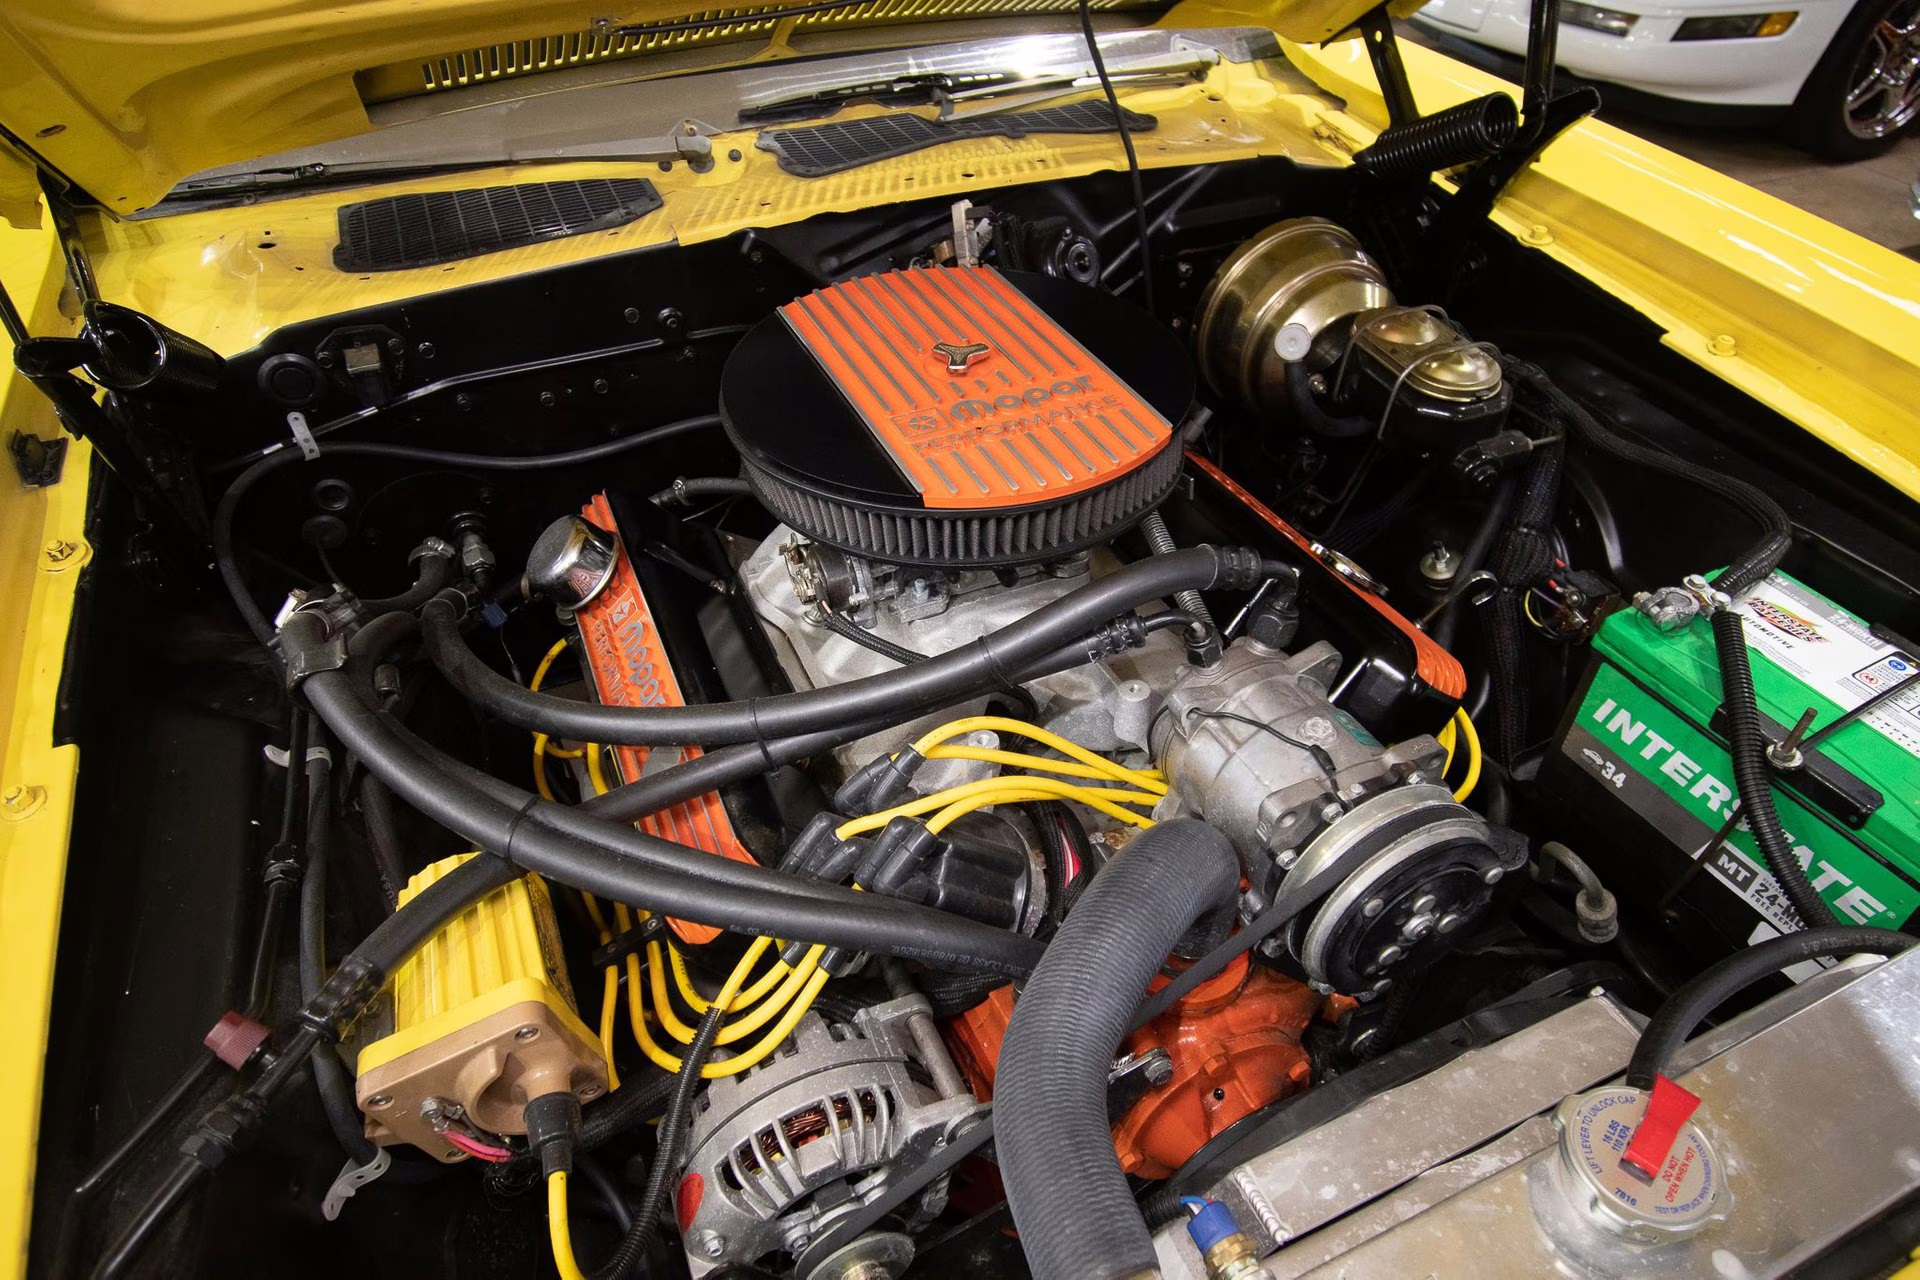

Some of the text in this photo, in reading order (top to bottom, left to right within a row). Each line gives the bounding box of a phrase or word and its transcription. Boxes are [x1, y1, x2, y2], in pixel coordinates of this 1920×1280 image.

[912, 394, 1122, 452] PERFORMANCE
[1601, 761, 1627, 789] 34
[1717, 853, 1751, 882] MT
[1750, 893, 1796, 931] FREE REPL
[1580, 1095, 1637, 1175] LIFT LEVER TO UNLOCK CAP
[1606, 1119, 1621, 1137] LBS
[1661, 1154, 1681, 1183] DO NOT
[1664, 1145, 1697, 1204] OPEN WHEN HOT
